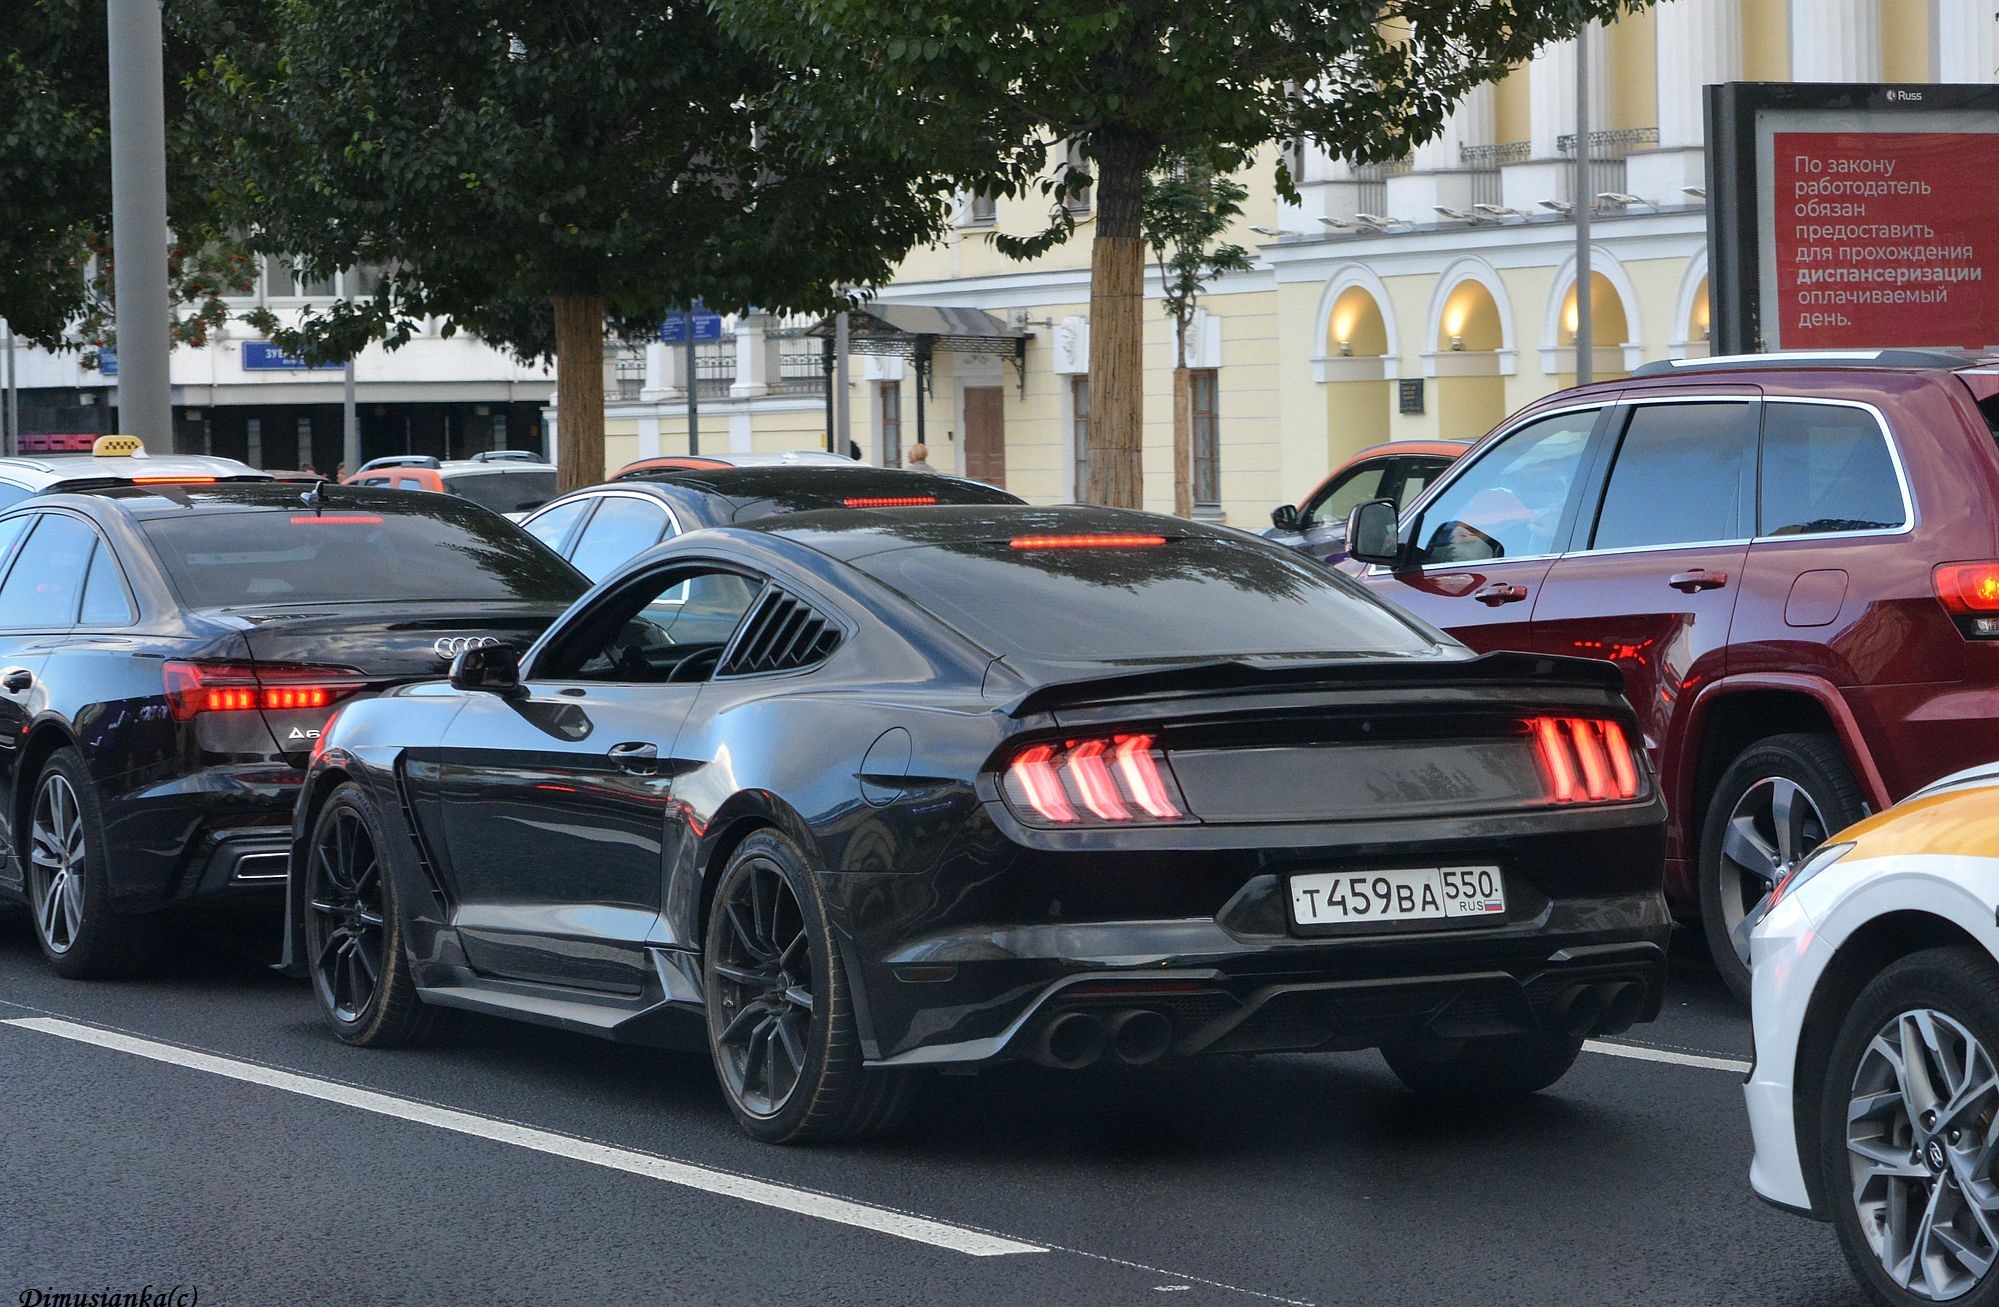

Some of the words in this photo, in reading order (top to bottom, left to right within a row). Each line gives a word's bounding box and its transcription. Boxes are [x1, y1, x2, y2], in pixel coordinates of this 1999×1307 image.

[1898, 90, 1922, 101] Russ
[1794, 155, 1823, 173] По
[1828, 157, 1896, 177] закону
[1795, 176, 1932, 198] работодатель
[1794, 199, 1866, 217] обязан
[1795, 223, 1934, 242] предоставить
[1796, 247, 1833, 263] для
[1839, 245, 1973, 264] прохождения
[1796, 266, 1983, 286] диспансеризации
[1798, 286, 1948, 305] оплачиваемый
[1798, 312, 1852, 328] день.
[288, 727, 321, 739] A6
[1459, 901, 1484, 911] RUS
